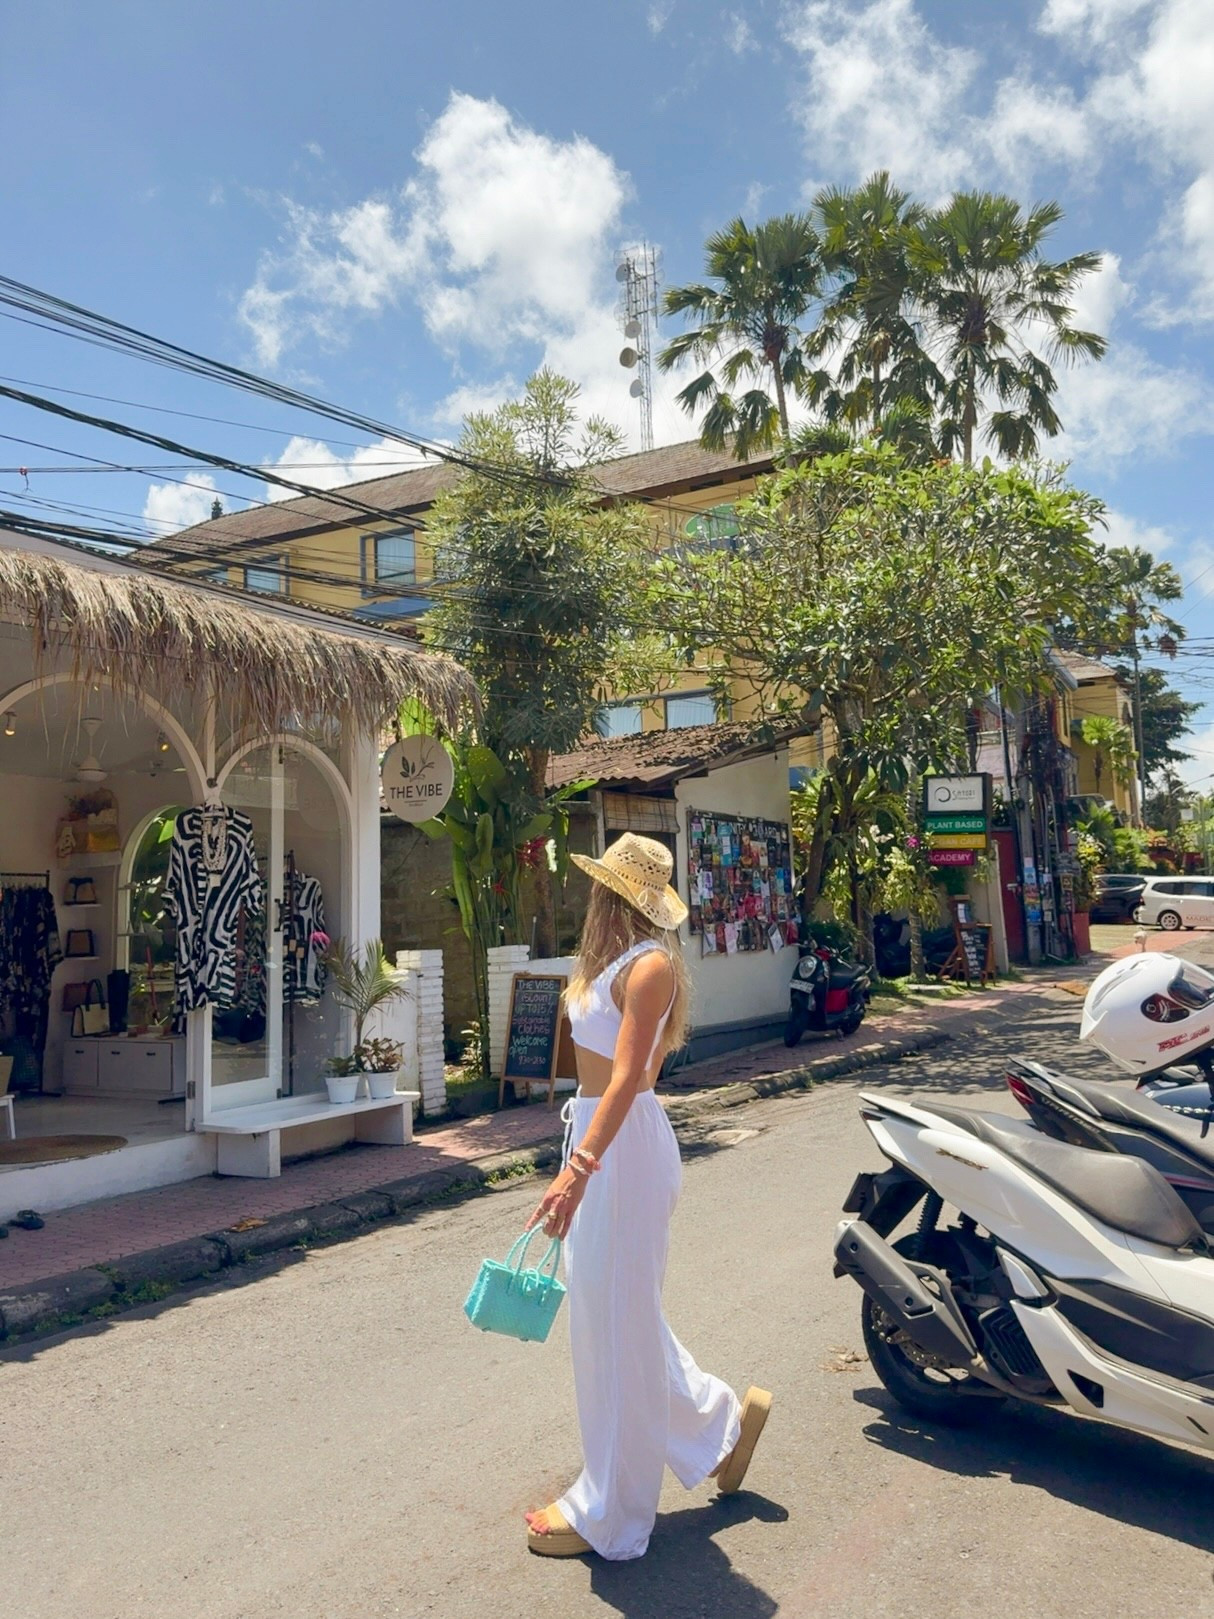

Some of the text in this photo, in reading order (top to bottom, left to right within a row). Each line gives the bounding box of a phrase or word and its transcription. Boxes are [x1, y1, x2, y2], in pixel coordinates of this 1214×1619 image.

[390, 783, 443, 800] THE VIBE
[927, 820, 983, 830] PLANT BASED
[518, 980, 533, 990] THE
